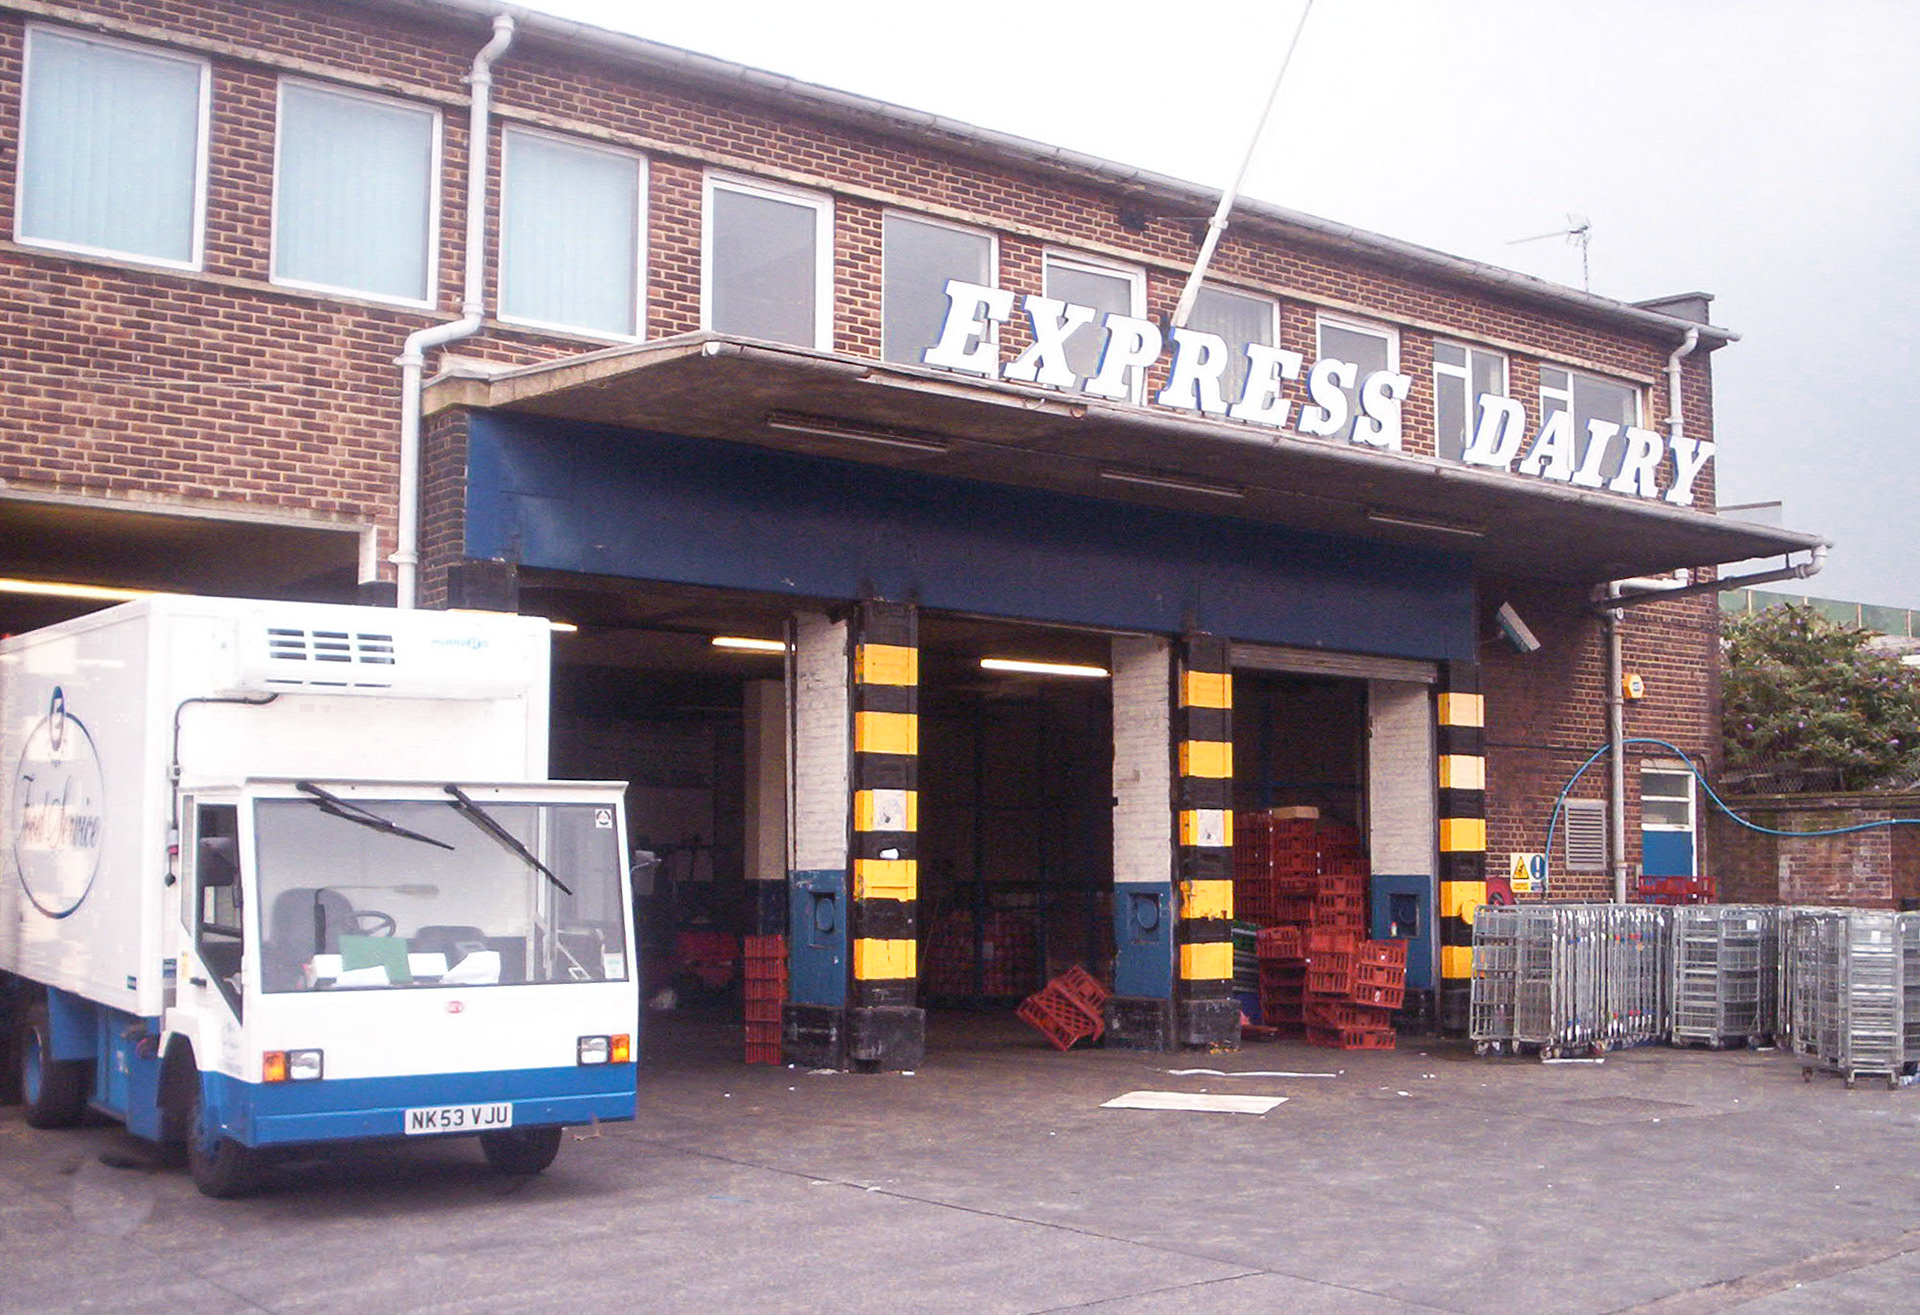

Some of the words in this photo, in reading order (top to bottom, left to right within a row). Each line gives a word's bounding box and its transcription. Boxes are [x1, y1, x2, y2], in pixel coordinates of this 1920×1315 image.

[922, 279, 1411, 450] EXPRESS
[1460, 393, 1716, 506] DAIRY
[411, 1108, 464, 1129] NK53
[471, 1106, 508, 1125] VJU
